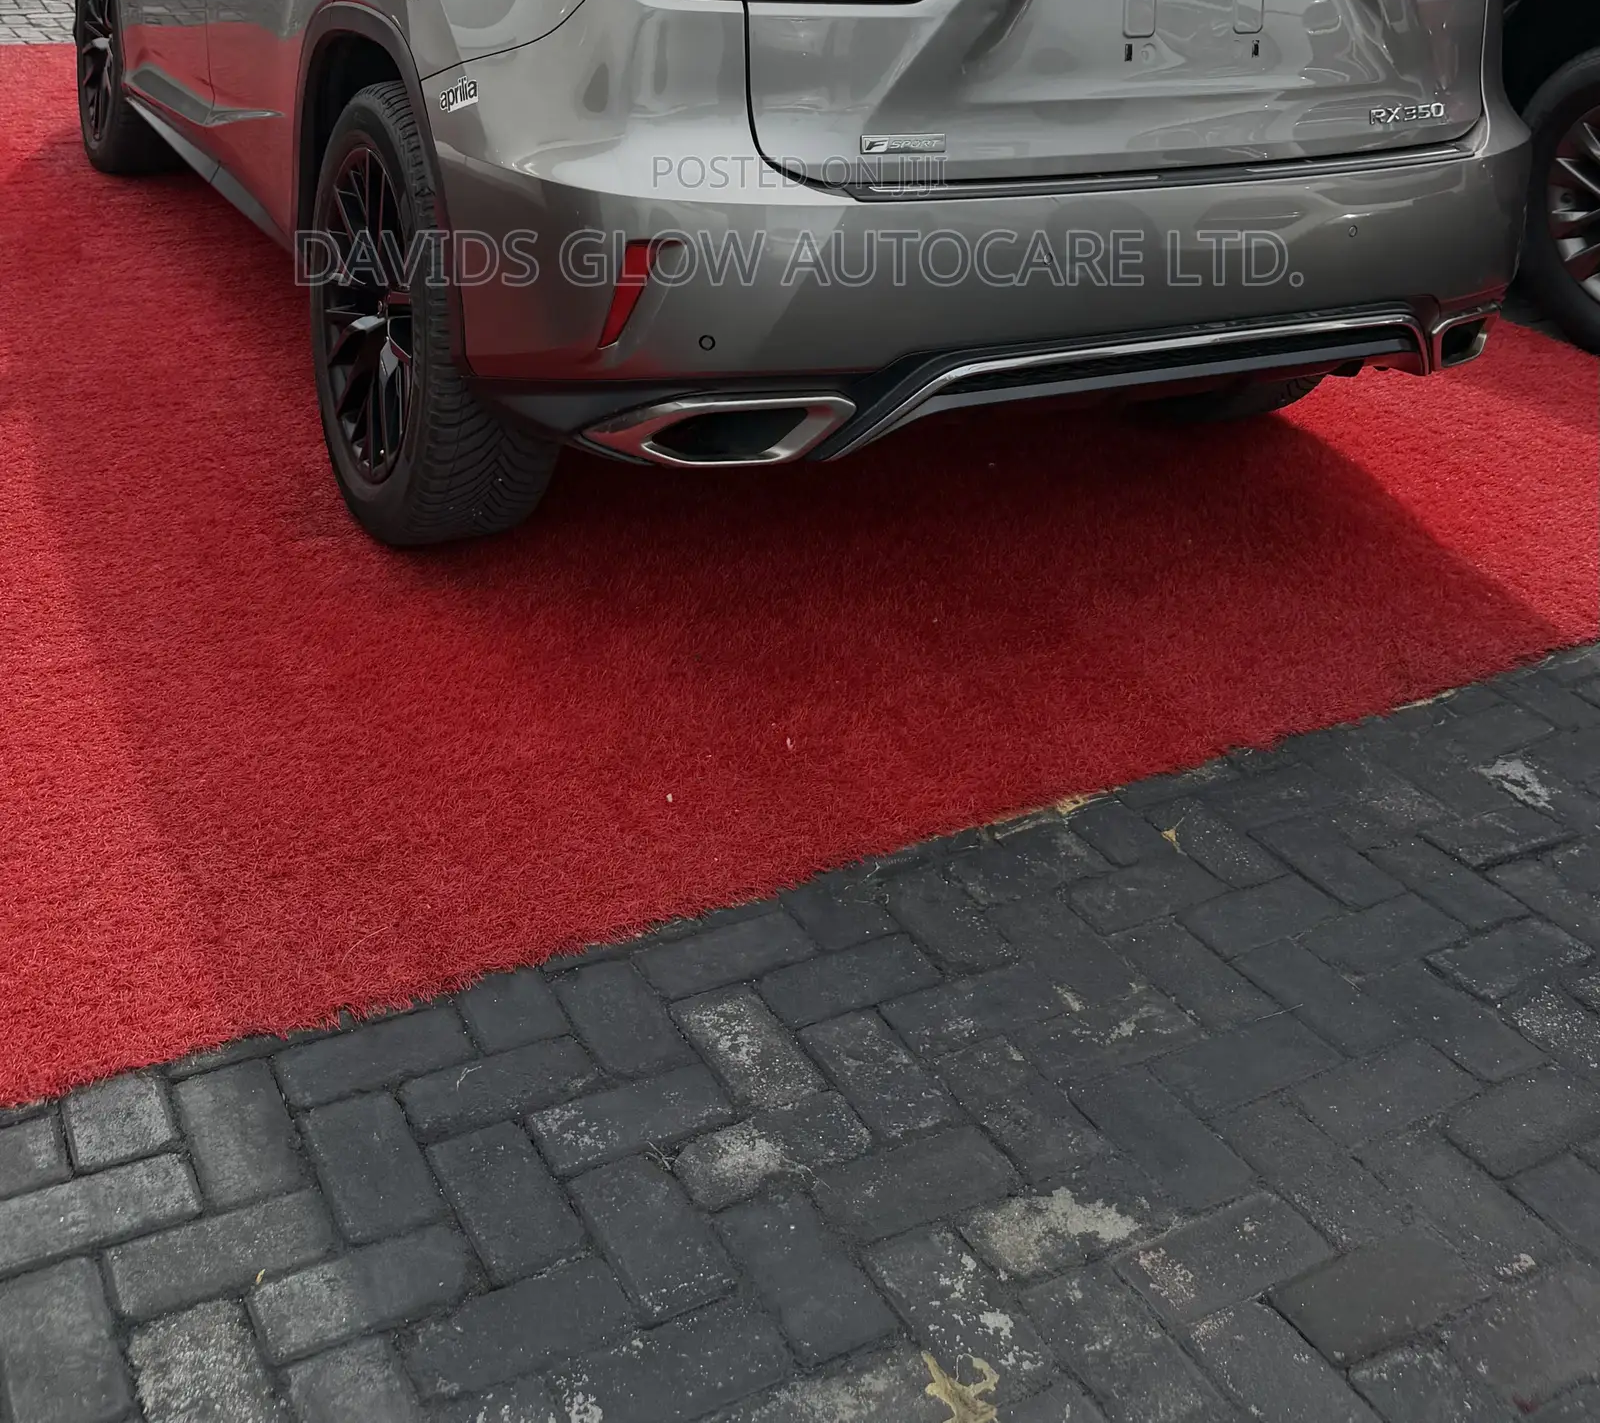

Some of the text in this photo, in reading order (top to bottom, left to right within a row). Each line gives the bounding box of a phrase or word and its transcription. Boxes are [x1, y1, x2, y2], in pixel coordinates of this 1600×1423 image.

[440, 76, 478, 111] aprilia
[1369, 102, 1444, 125] RX 350
[889, 139, 941, 149] SPORT
